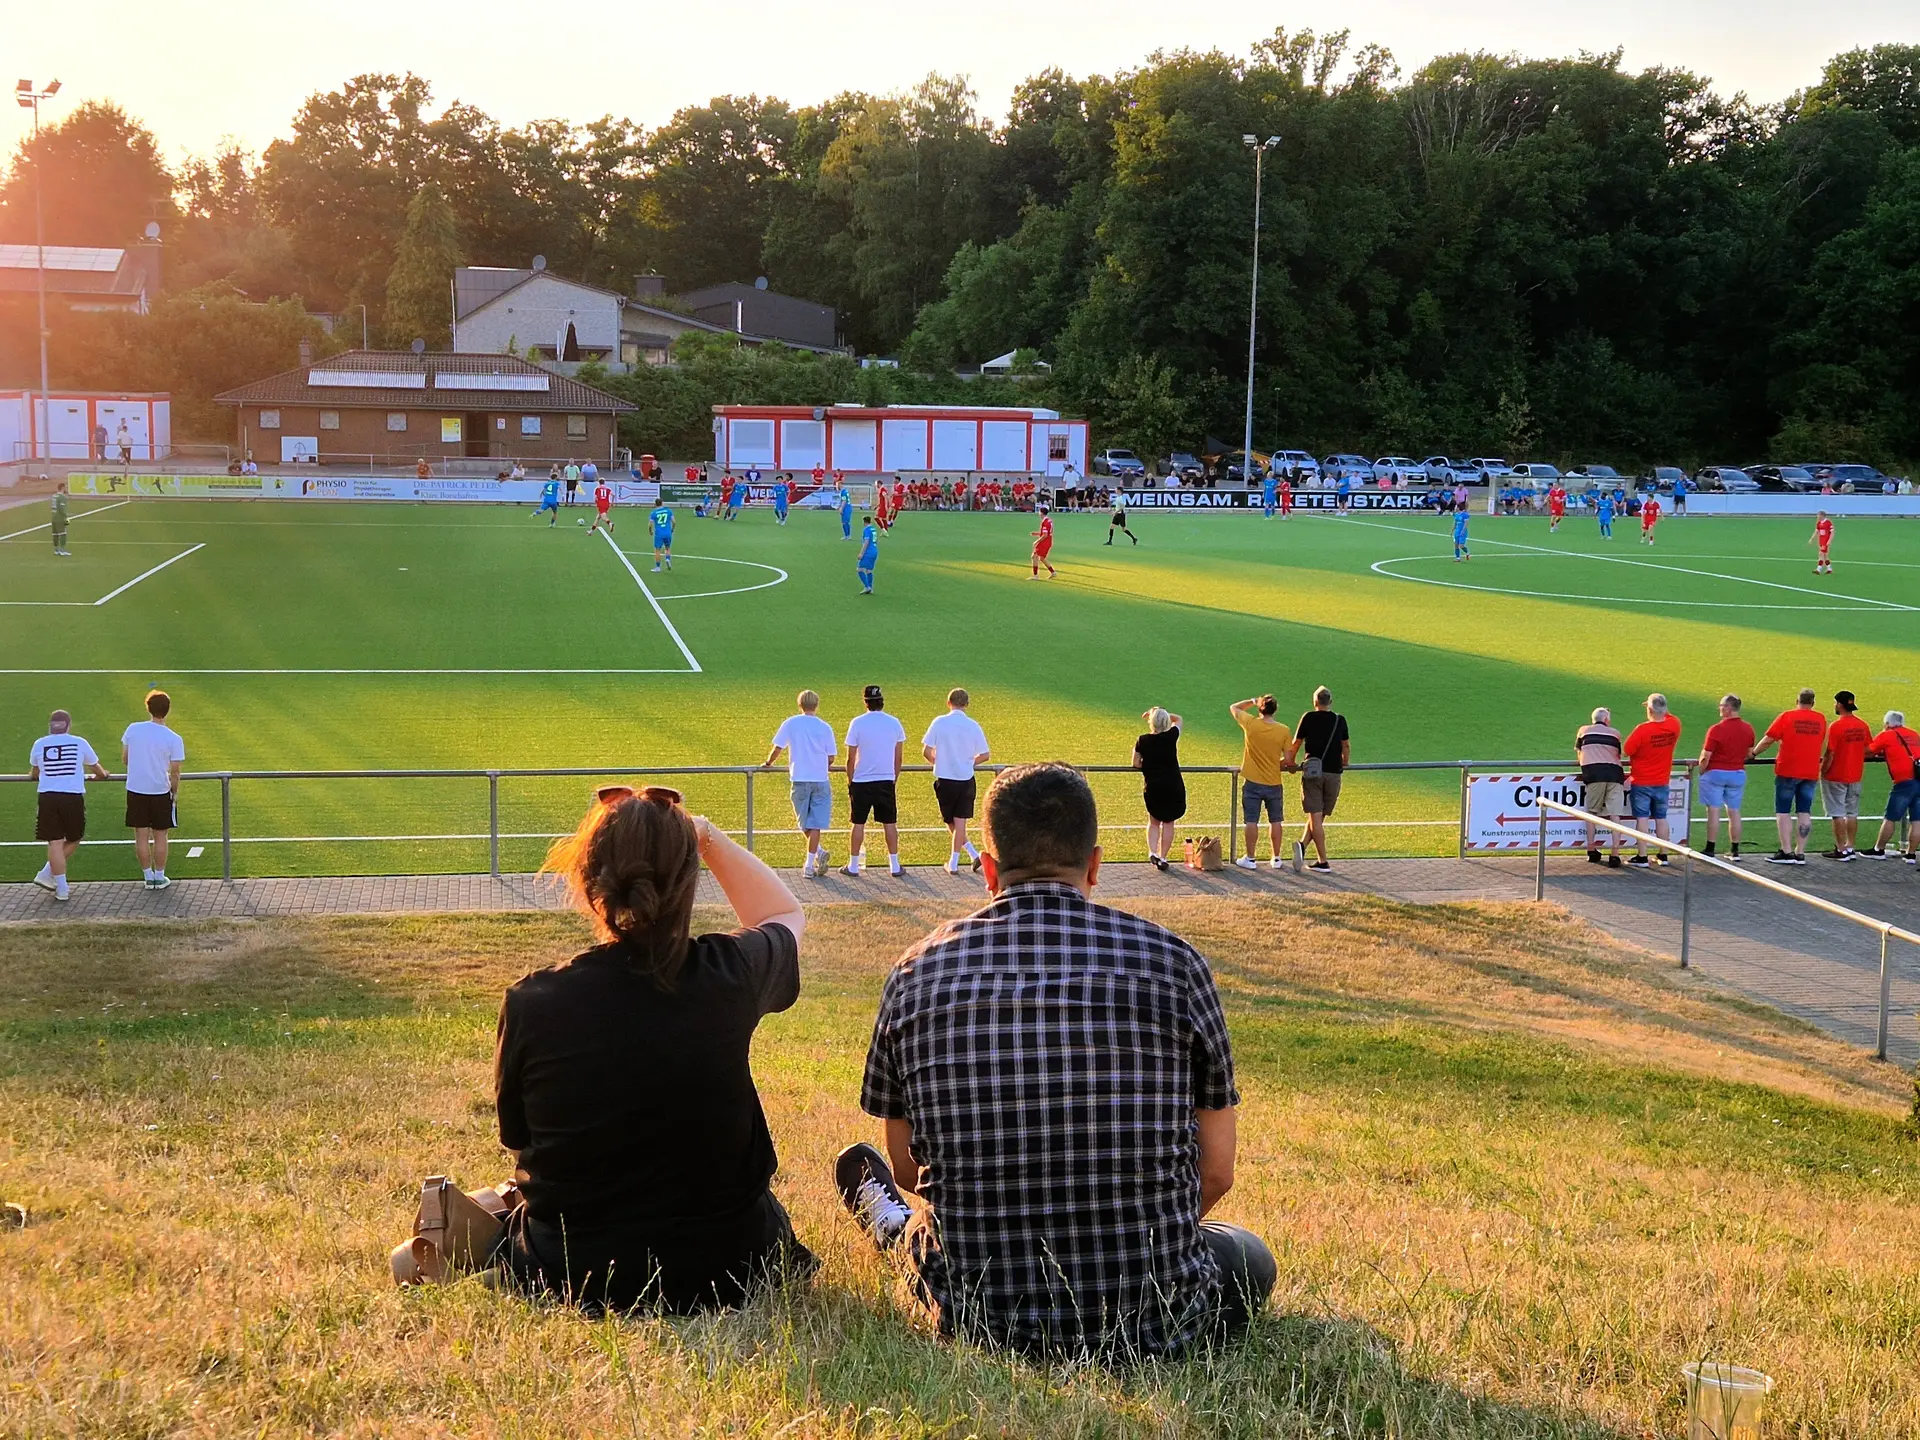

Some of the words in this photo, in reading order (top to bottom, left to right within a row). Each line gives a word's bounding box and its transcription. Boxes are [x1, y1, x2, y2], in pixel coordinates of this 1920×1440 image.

[316, 480, 347, 488] PHYSIO
[430, 481, 467, 489] PATRICK
[470, 481, 502, 489] PETERS
[600, 489, 607, 498] 11
[1110, 493, 1239, 506] MEINSAM.
[656, 513, 668, 524] 27
